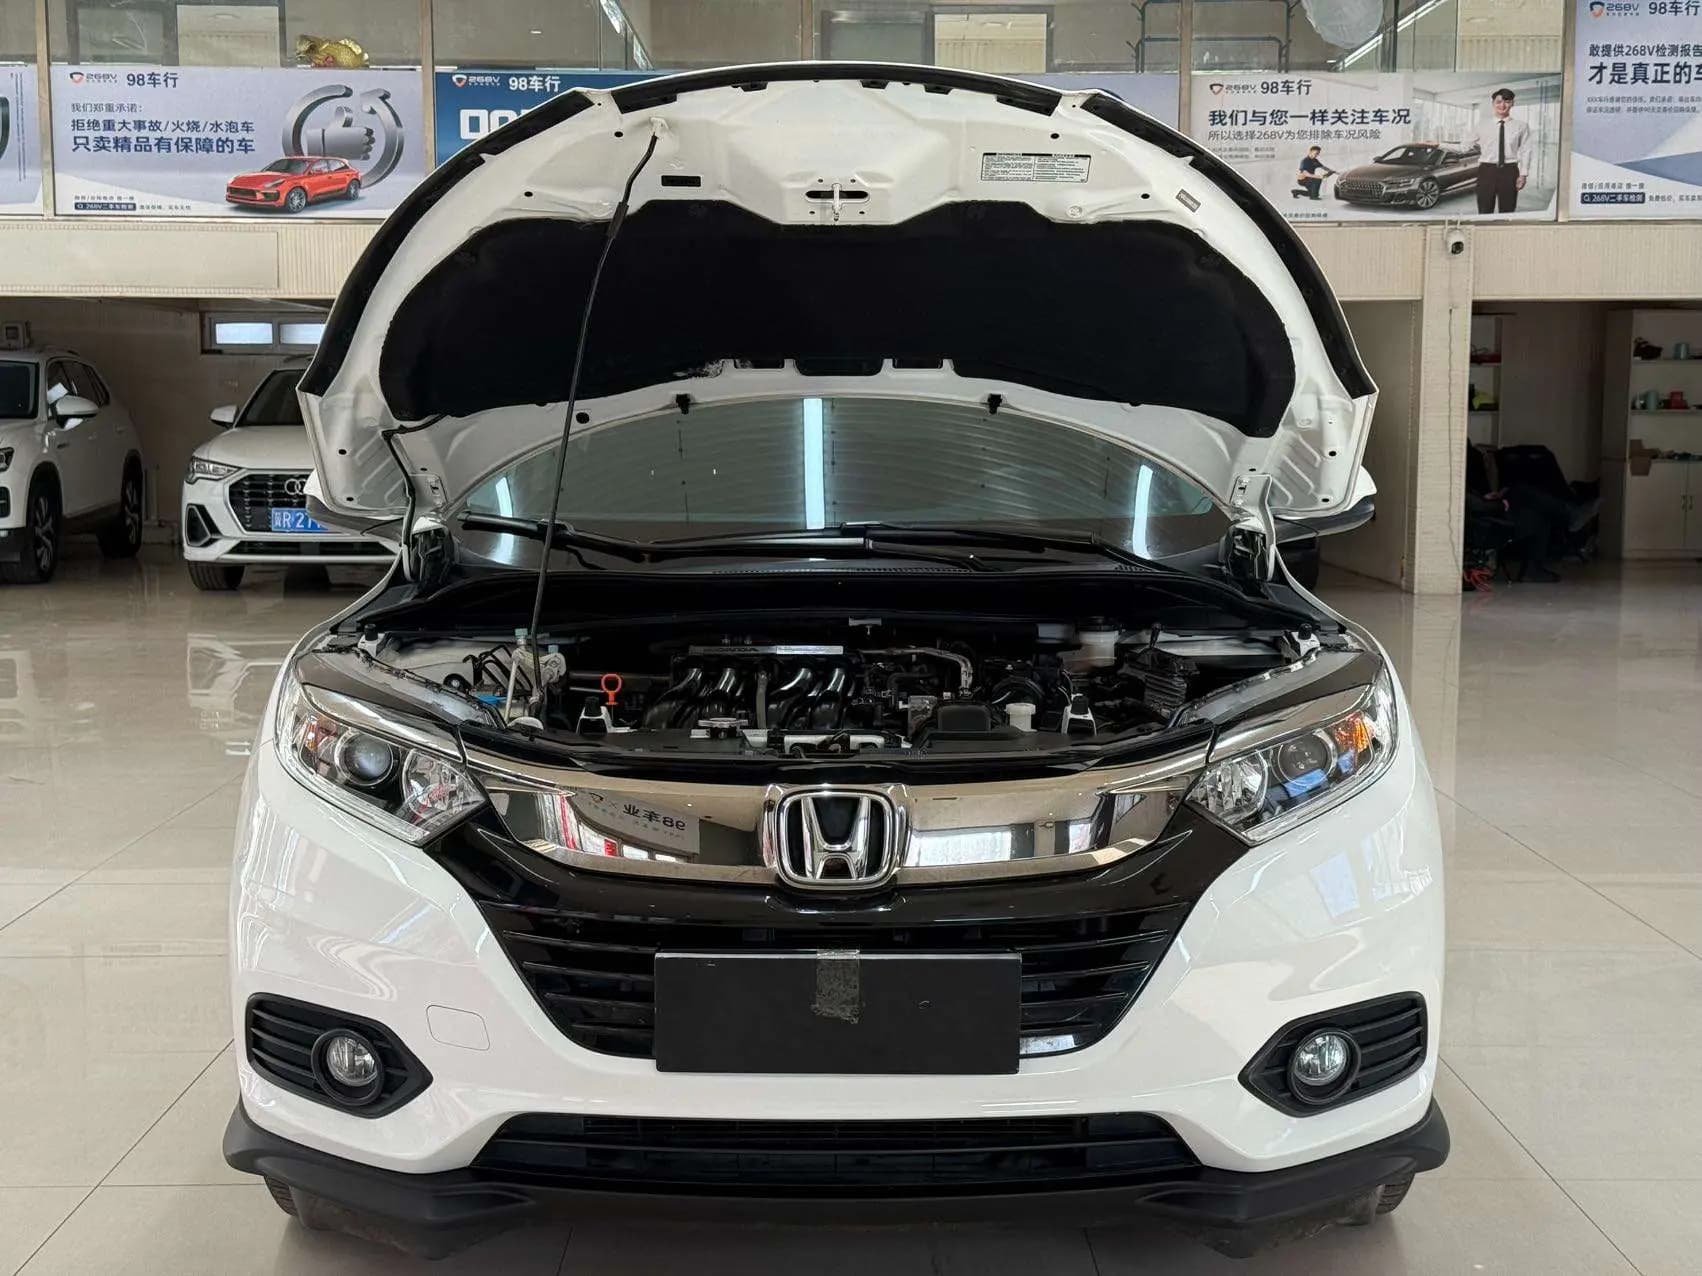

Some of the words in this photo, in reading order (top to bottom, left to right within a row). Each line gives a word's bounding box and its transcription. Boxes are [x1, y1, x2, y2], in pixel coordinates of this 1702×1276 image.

[1649, 0, 1700, 16] 98车行
[127, 72, 178, 88] 98车行
[509, 76, 561, 92] 98车行
[1261, 80, 1312, 96] 98车行
[1208, 108, 1411, 126] 我们与您一样关注车况
[71, 119, 255, 134] 拒绝重大事故/火烧/水泡车
[1208, 128, 1381, 141] 所以选择268V为您排除车况风险
[72, 136, 255, 154] 只卖精品有保障的车
